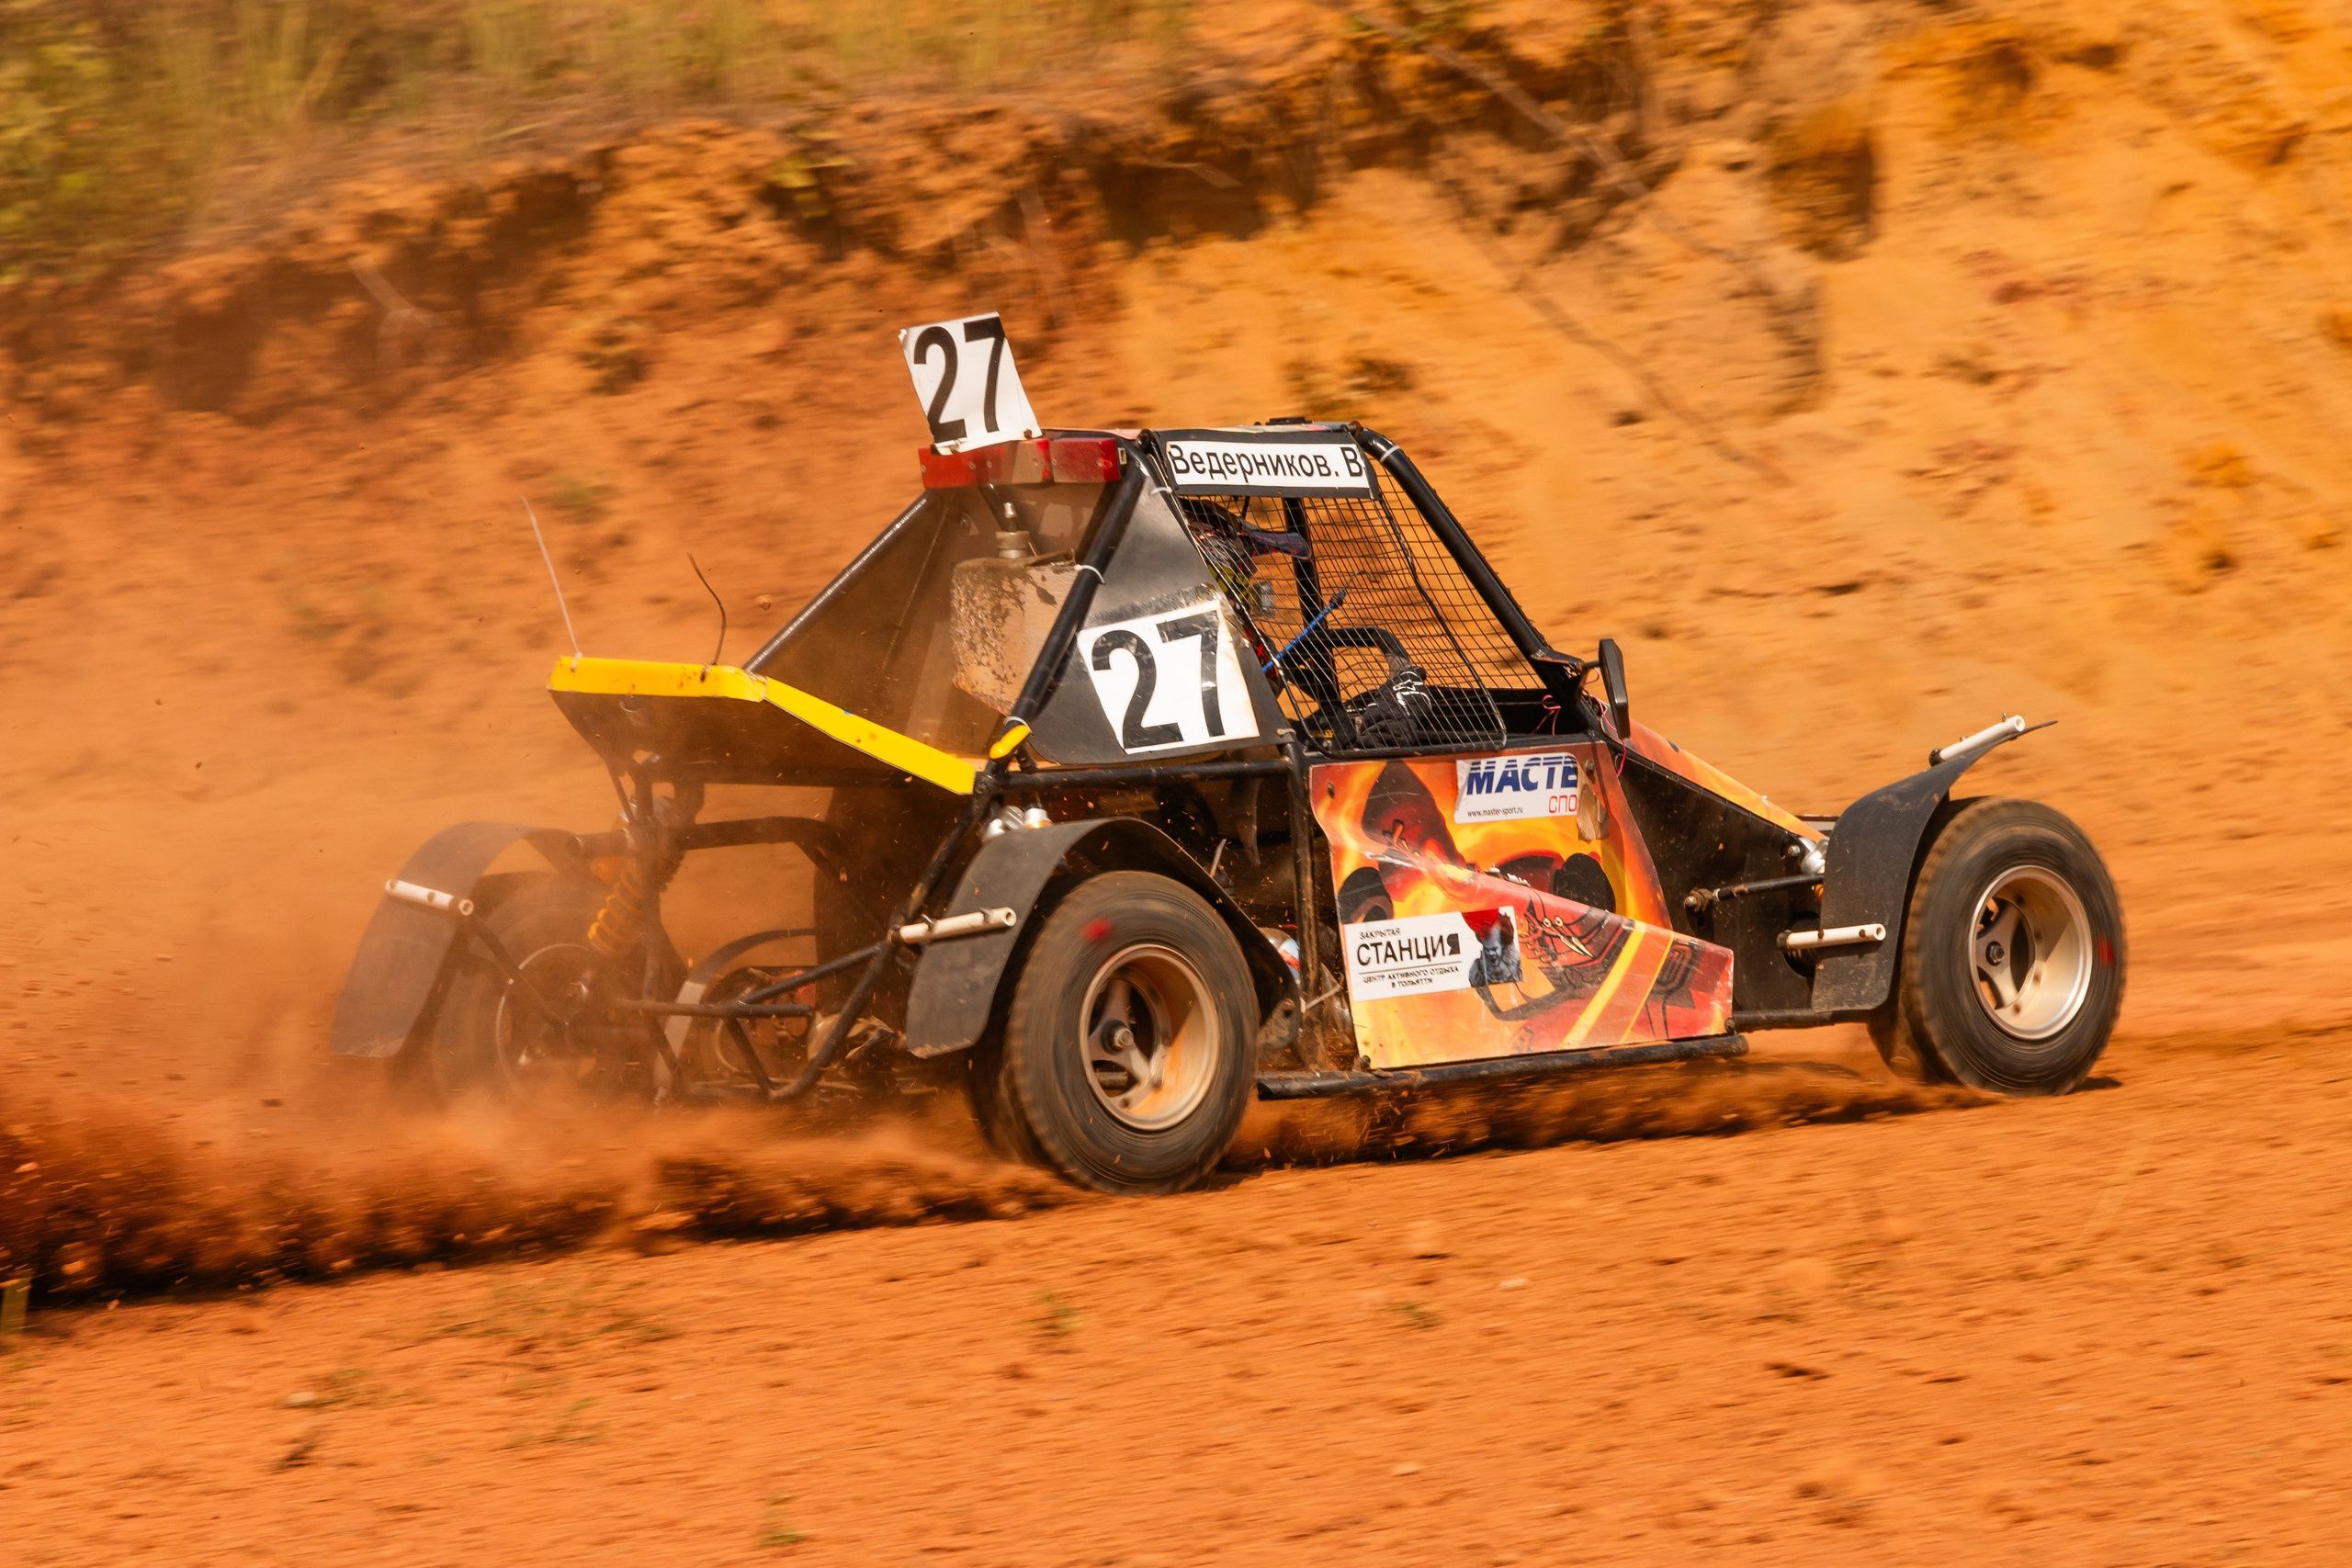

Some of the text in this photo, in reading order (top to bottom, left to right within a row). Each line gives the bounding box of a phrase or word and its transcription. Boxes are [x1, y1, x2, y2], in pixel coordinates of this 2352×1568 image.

[913, 316, 1007, 443] 27
[1169, 444, 1340, 483] Ведерников.
[1091, 610, 1225, 750] 27
[1467, 807, 1524, 818] www.master-sport.ru
[1360, 928, 1401, 940] ЗАКРЫТАЯ
[1357, 932, 1461, 966] СТАНЦИЯ
[1363, 965, 1459, 985] ЦЕНТР АКТИВНОГО ОТДЫХА
[1398, 977, 1433, 987] ТОЛЬЯТТИ
